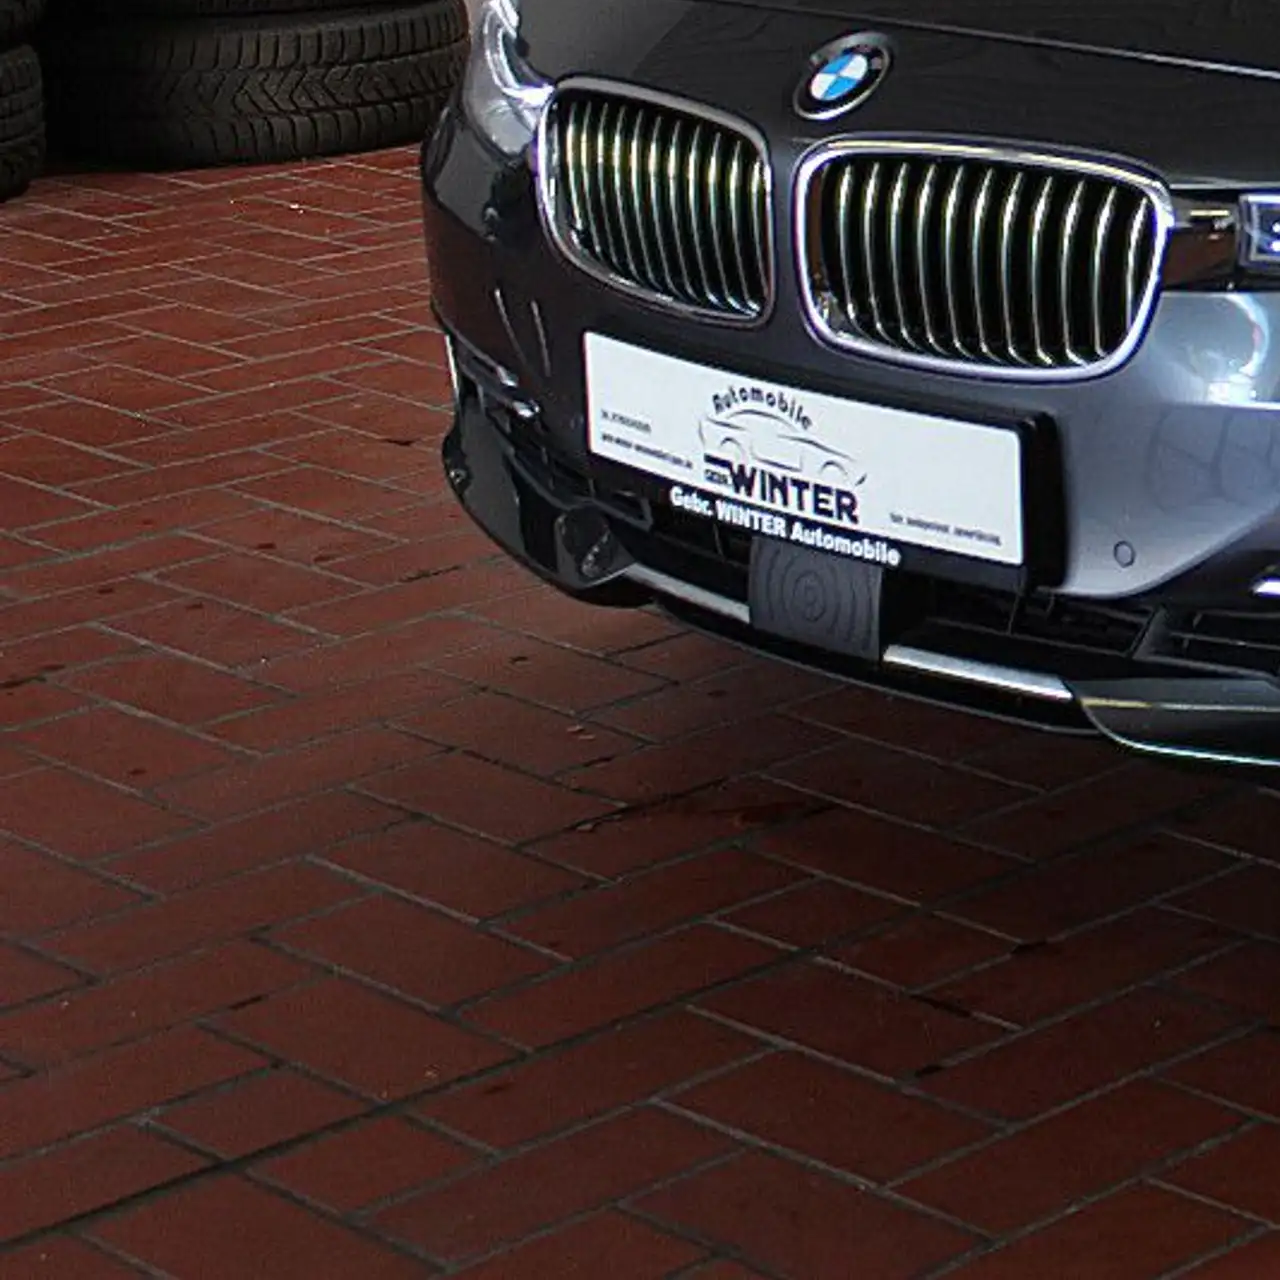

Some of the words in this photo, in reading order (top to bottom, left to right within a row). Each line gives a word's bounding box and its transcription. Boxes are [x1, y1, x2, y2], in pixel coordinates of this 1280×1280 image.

[712, 386, 813, 430] Automobile
[731, 463, 860, 525] WINTER
[670, 485, 713, 516] Gebr.
[715, 499, 786, 538] WINTER
[790, 522, 901, 567] Automobile
